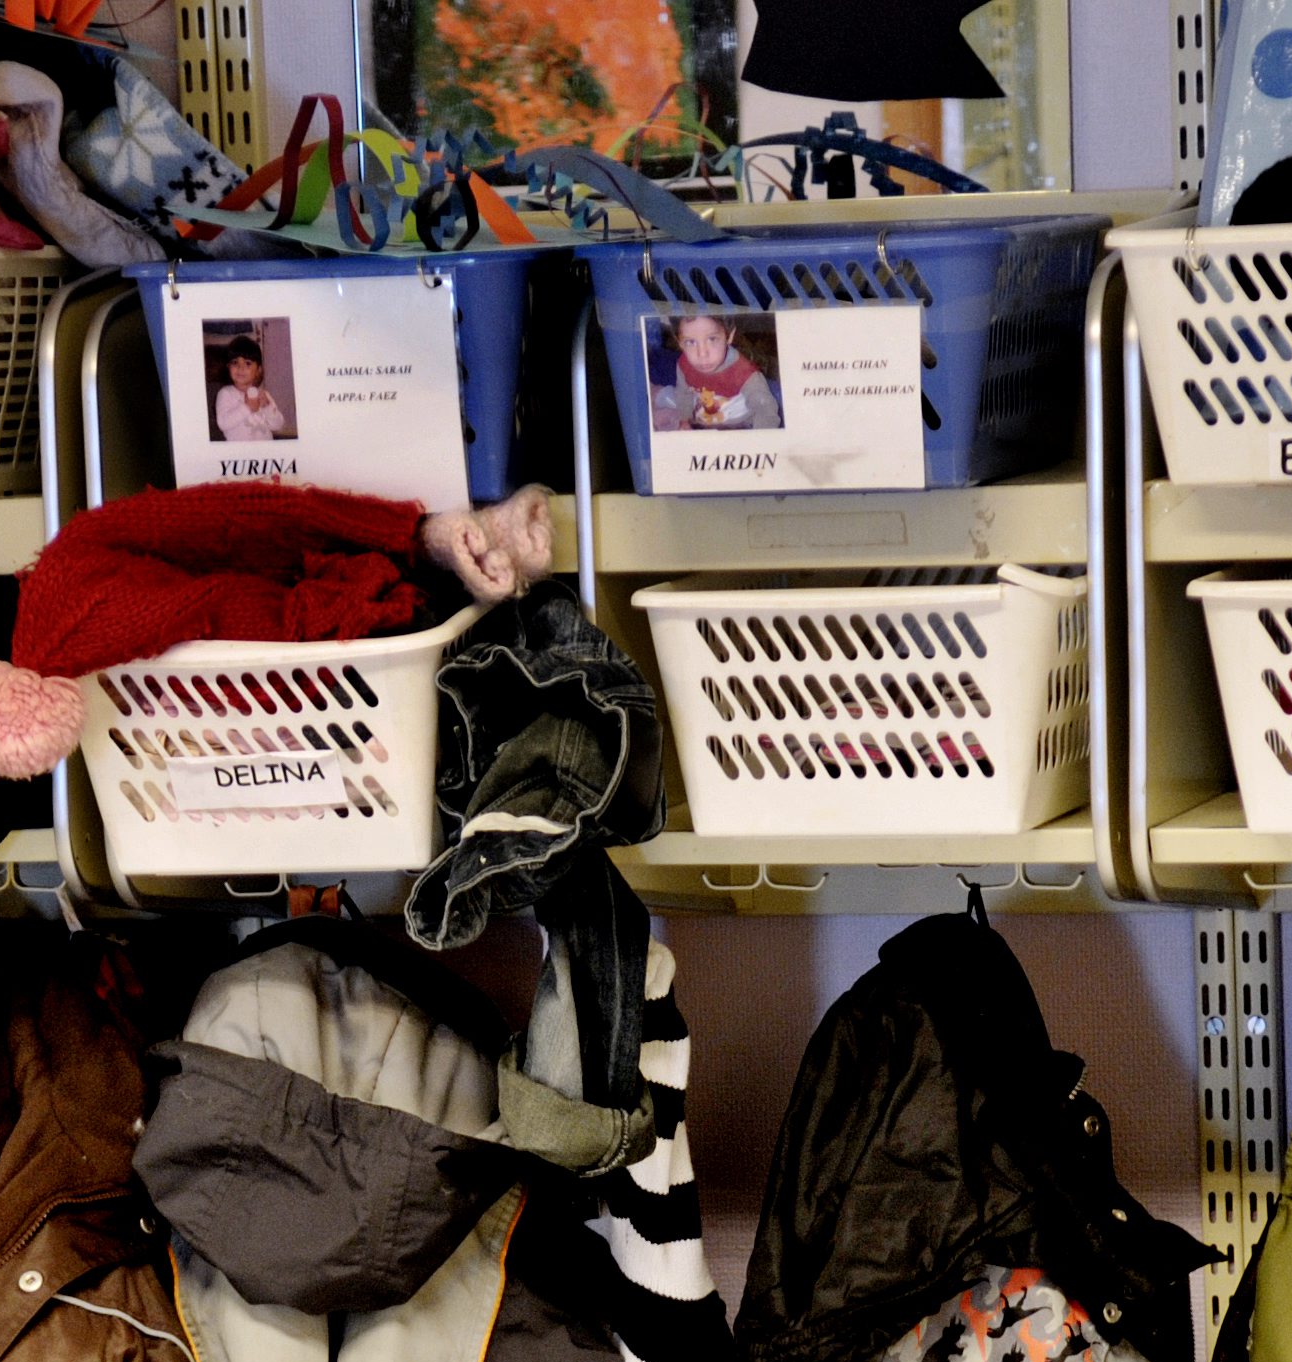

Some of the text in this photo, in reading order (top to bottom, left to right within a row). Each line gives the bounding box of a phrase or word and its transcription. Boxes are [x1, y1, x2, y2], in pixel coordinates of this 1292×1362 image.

[326, 365, 413, 377] MAMMA: SARAH
[801, 360, 849, 371] MAMMA:
[328, 391, 398, 402] PAPPA: FAEZ
[803, 386, 841, 397] PAPPA:
[220, 458, 298, 476] YURINA
[689, 453, 778, 472] MARDIN
[213, 761, 326, 788] DELINA
